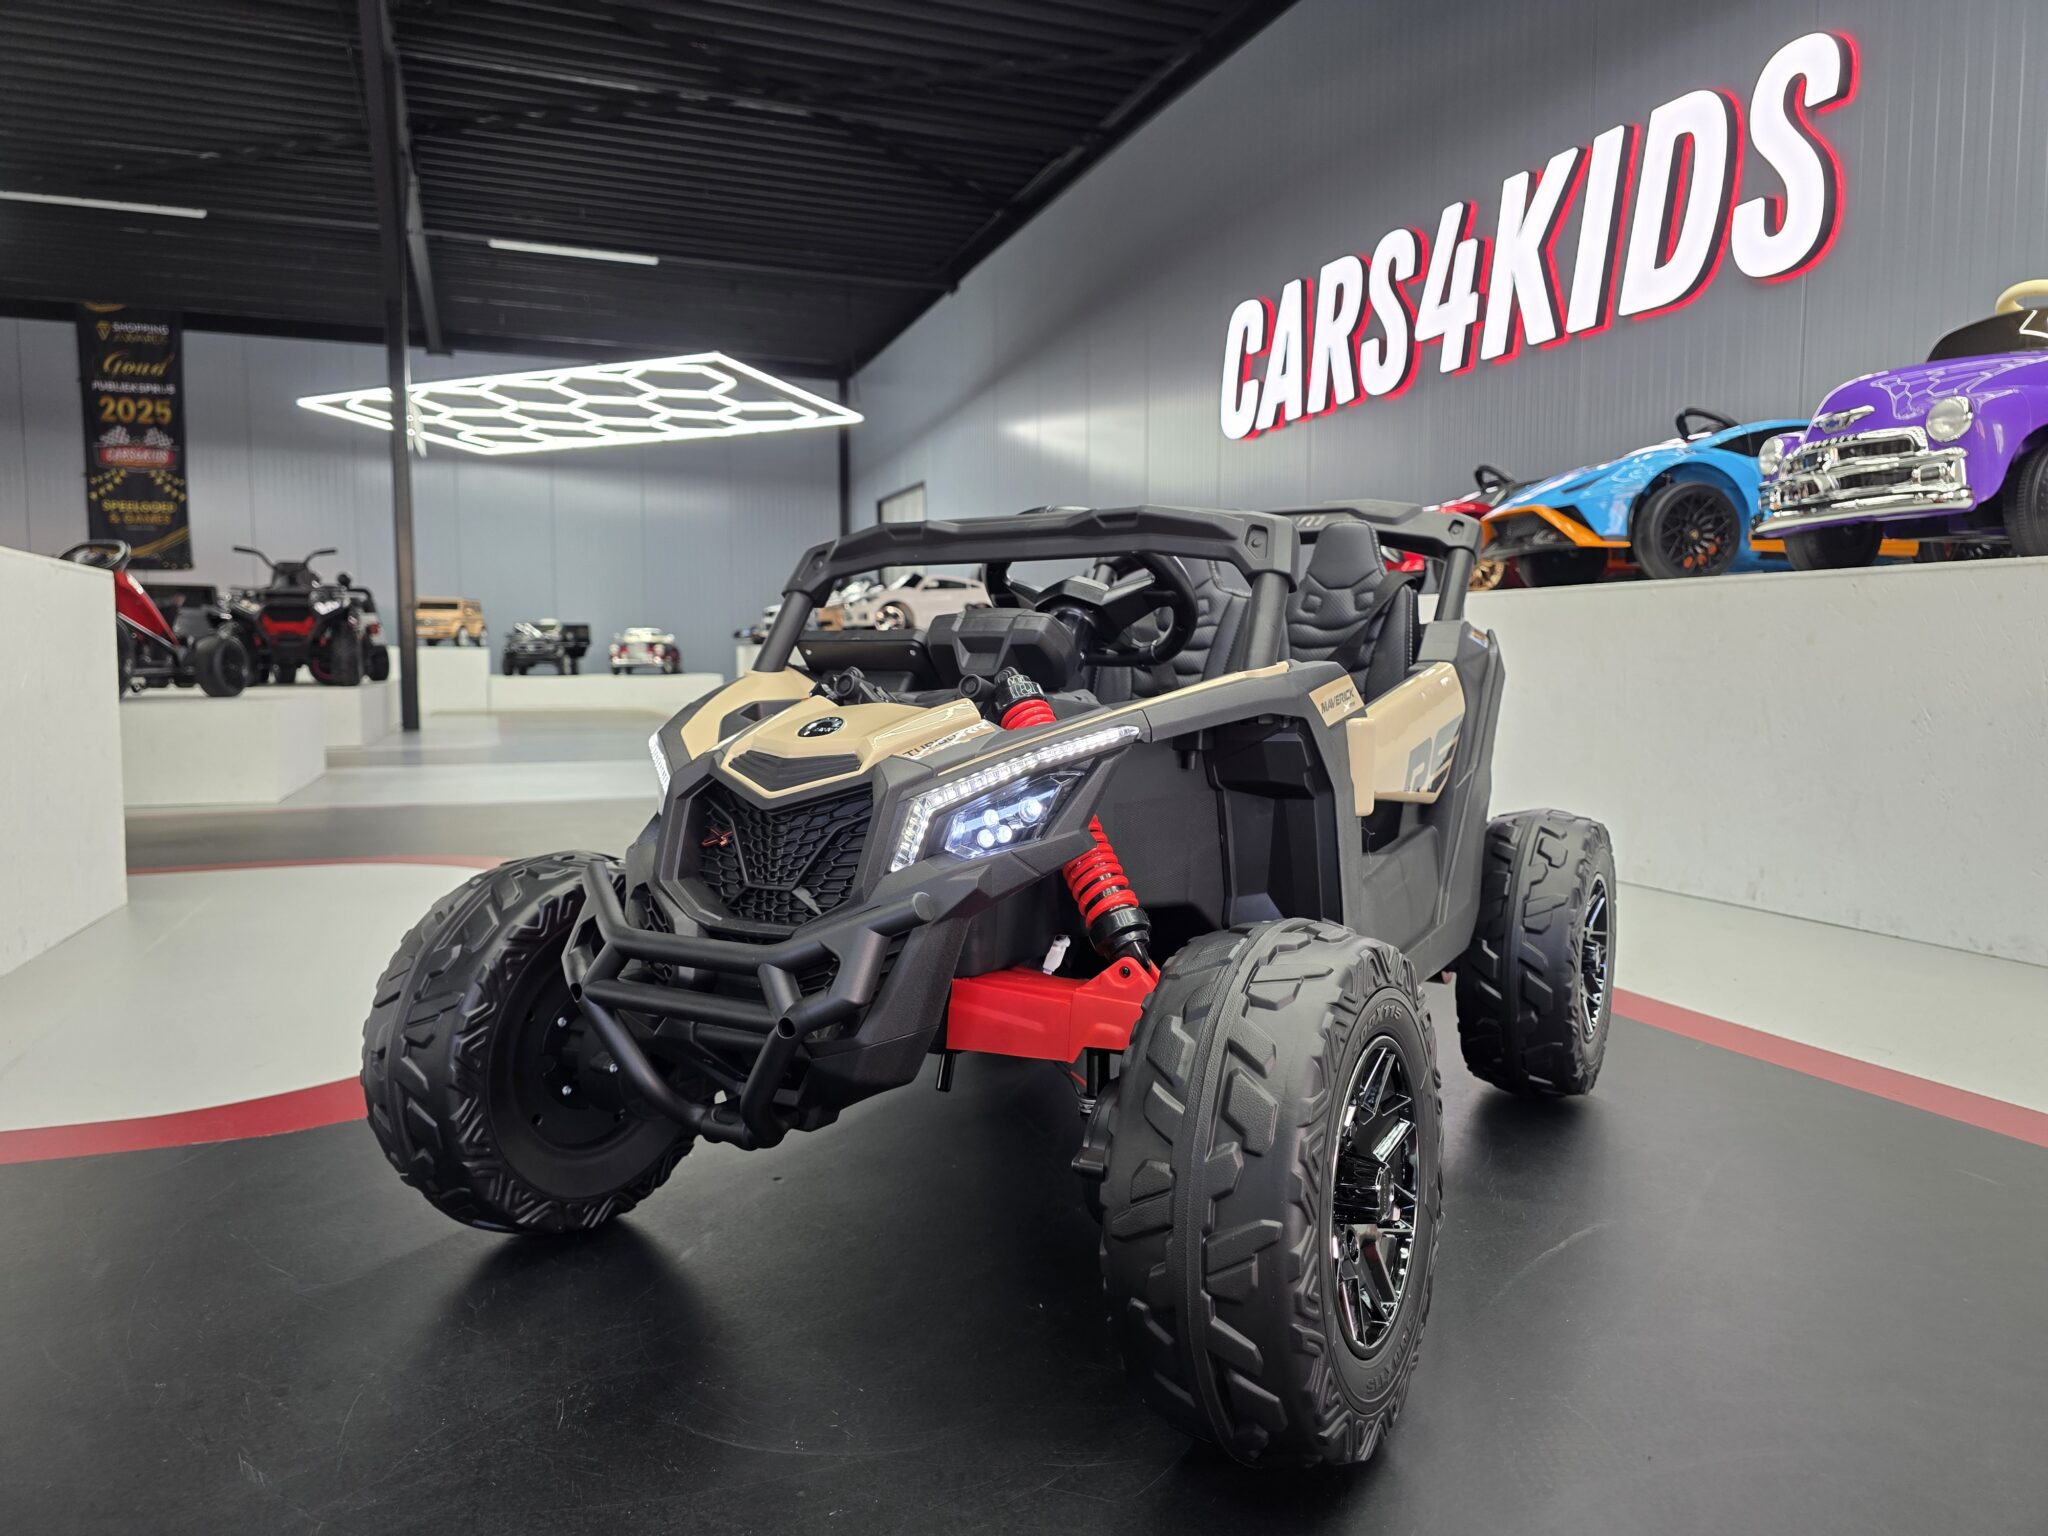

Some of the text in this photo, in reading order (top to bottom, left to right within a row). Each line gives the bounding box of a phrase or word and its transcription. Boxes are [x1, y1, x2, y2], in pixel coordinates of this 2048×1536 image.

[1221, 31, 1848, 440] CARS4KIDS
[112, 321, 170, 336] SHOPPING
[103, 350, 176, 378] Goud
[99, 396, 173, 425] 2025
[1320, 686, 1355, 714] MAVERICK
